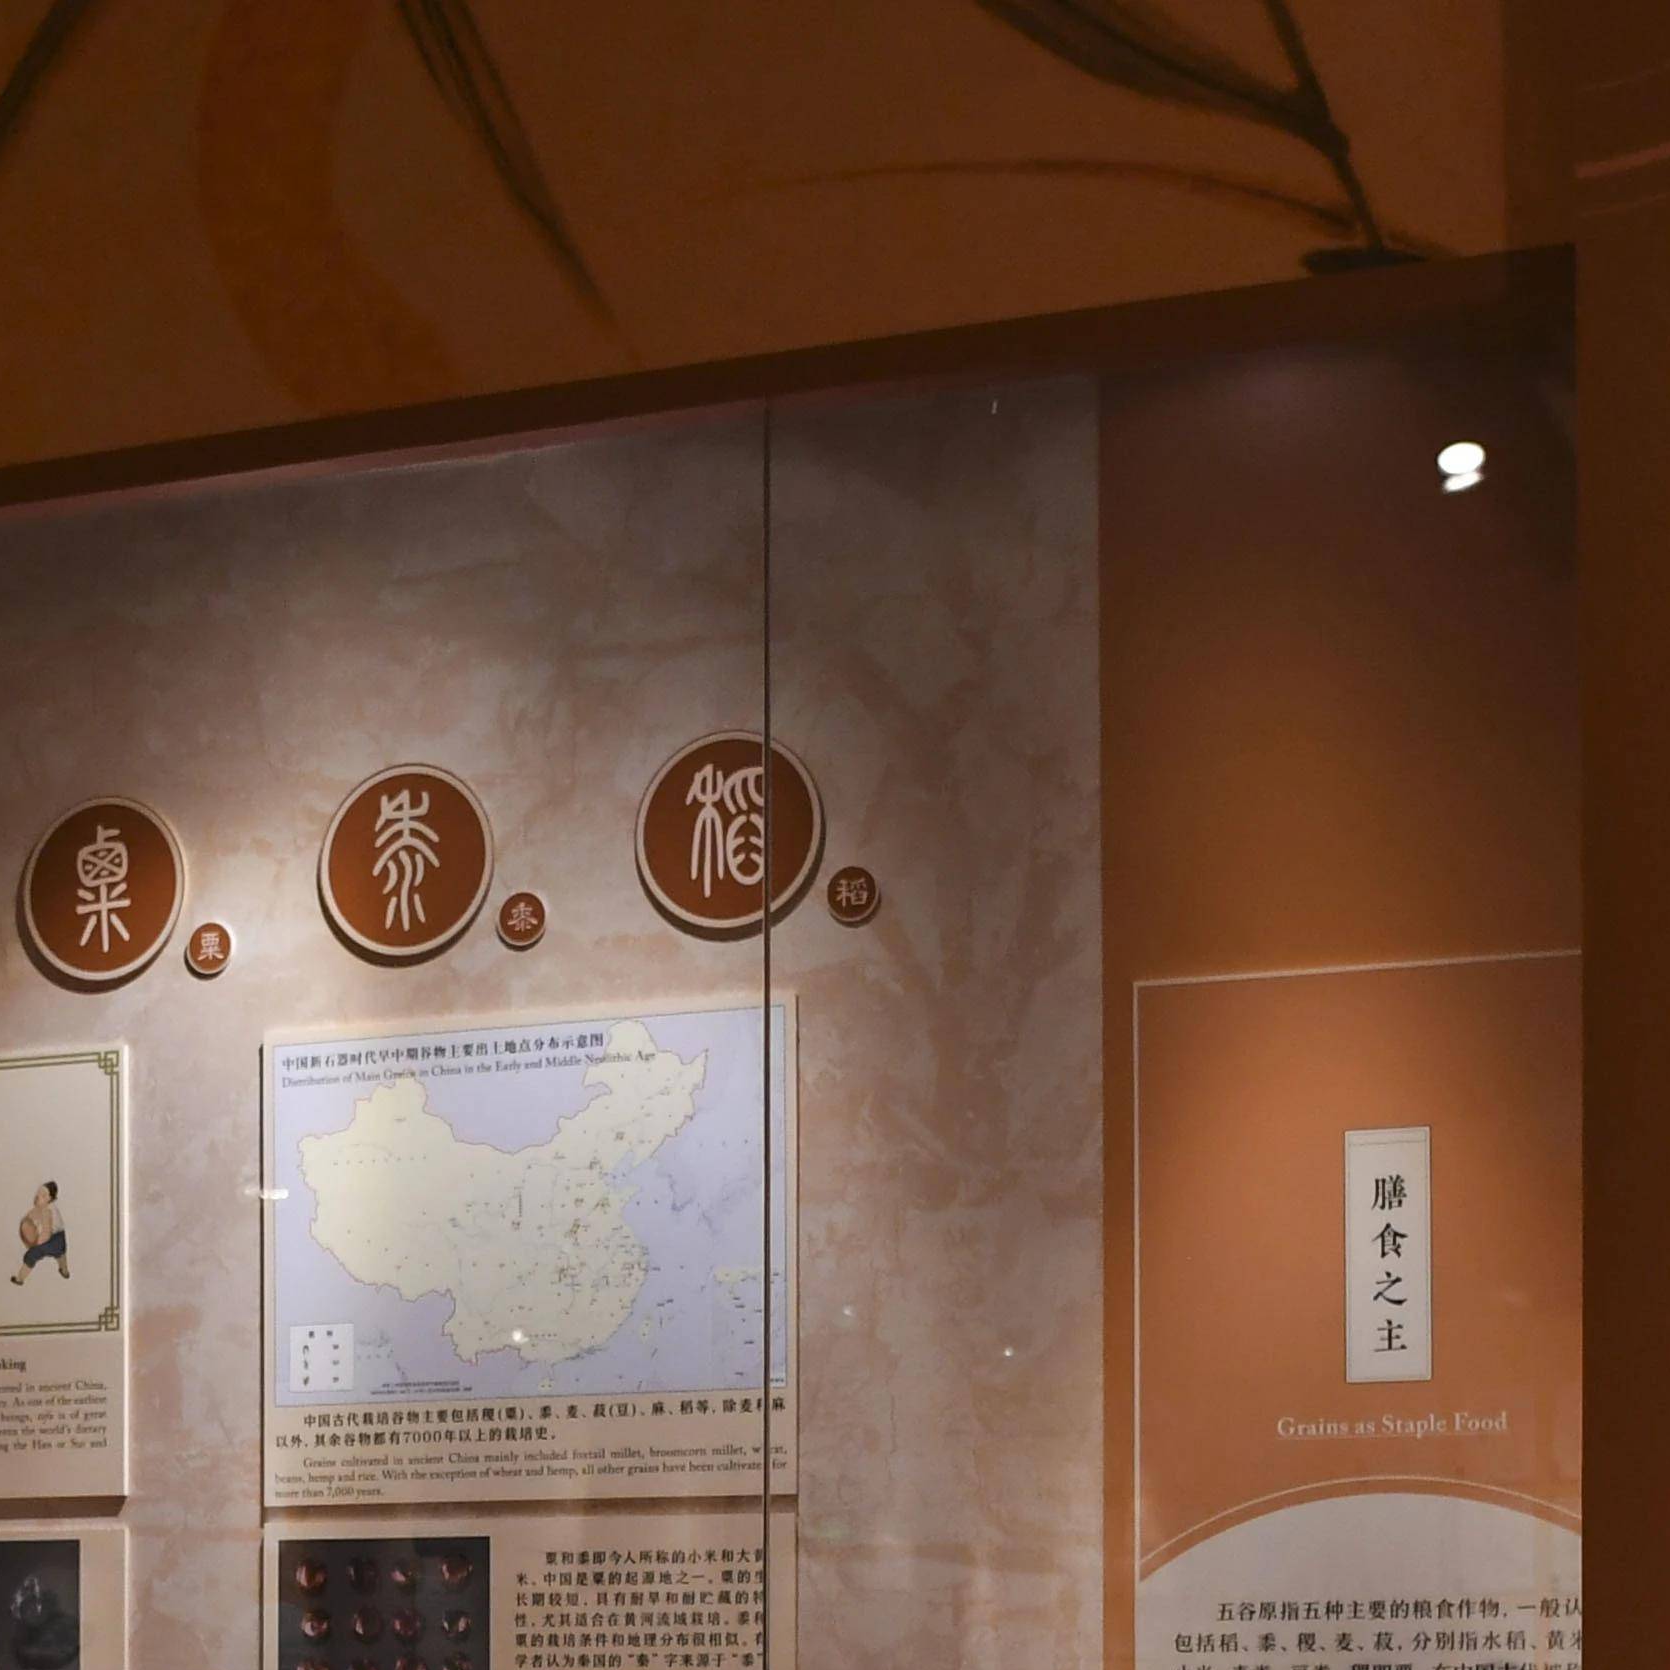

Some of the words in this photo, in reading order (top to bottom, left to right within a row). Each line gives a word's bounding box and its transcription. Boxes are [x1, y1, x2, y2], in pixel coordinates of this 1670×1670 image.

[836, 877, 869, 909] 稻
[507, 902, 539, 932] 黍
[198, 932, 225, 961] 粟
[431, 1066, 461, 1077] China
[477, 1062, 491, 1072] the
[495, 1060, 522, 1073] Early
[545, 1055, 581, 1067] Middle
[1371, 1174, 1409, 1353] 膳食之主
[1277, 1415, 1348, 1437] Grains
[1355, 1419, 1376, 1434] as
[1382, 1413, 1447, 1438] Staple
[1454, 1411, 1508, 1433] Food
